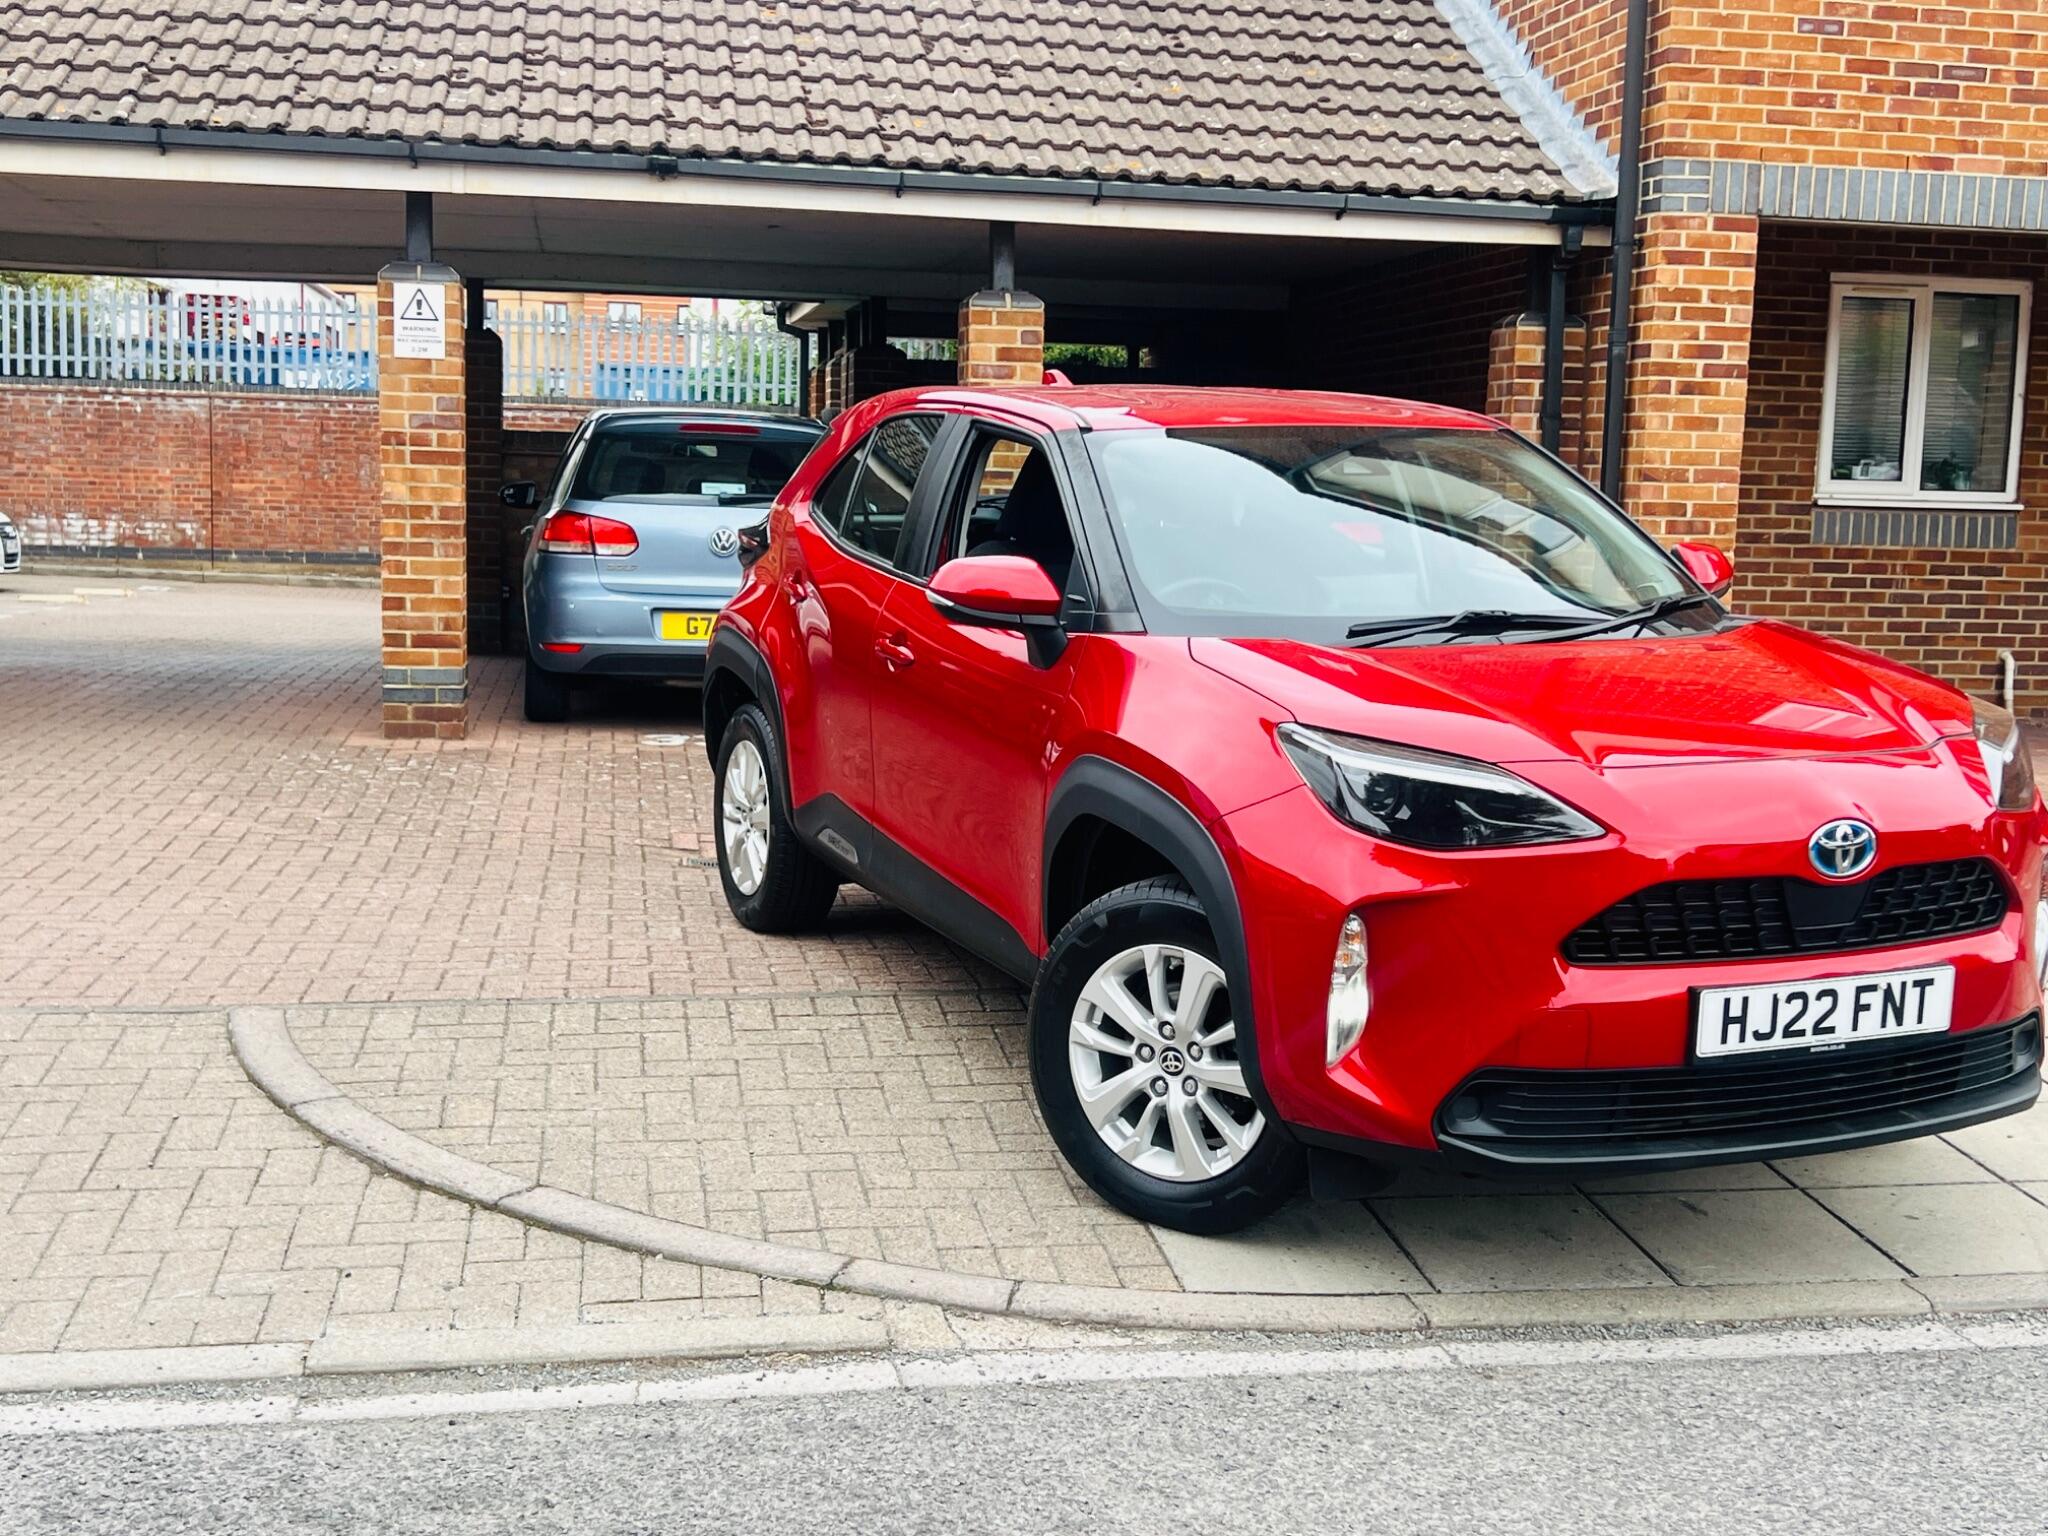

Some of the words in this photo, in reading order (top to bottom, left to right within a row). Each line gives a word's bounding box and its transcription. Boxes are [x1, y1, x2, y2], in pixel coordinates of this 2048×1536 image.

[686, 617, 717, 636] G7
[1720, 989, 1839, 1045] HJ22
[1851, 977, 1935, 1031] FNT
